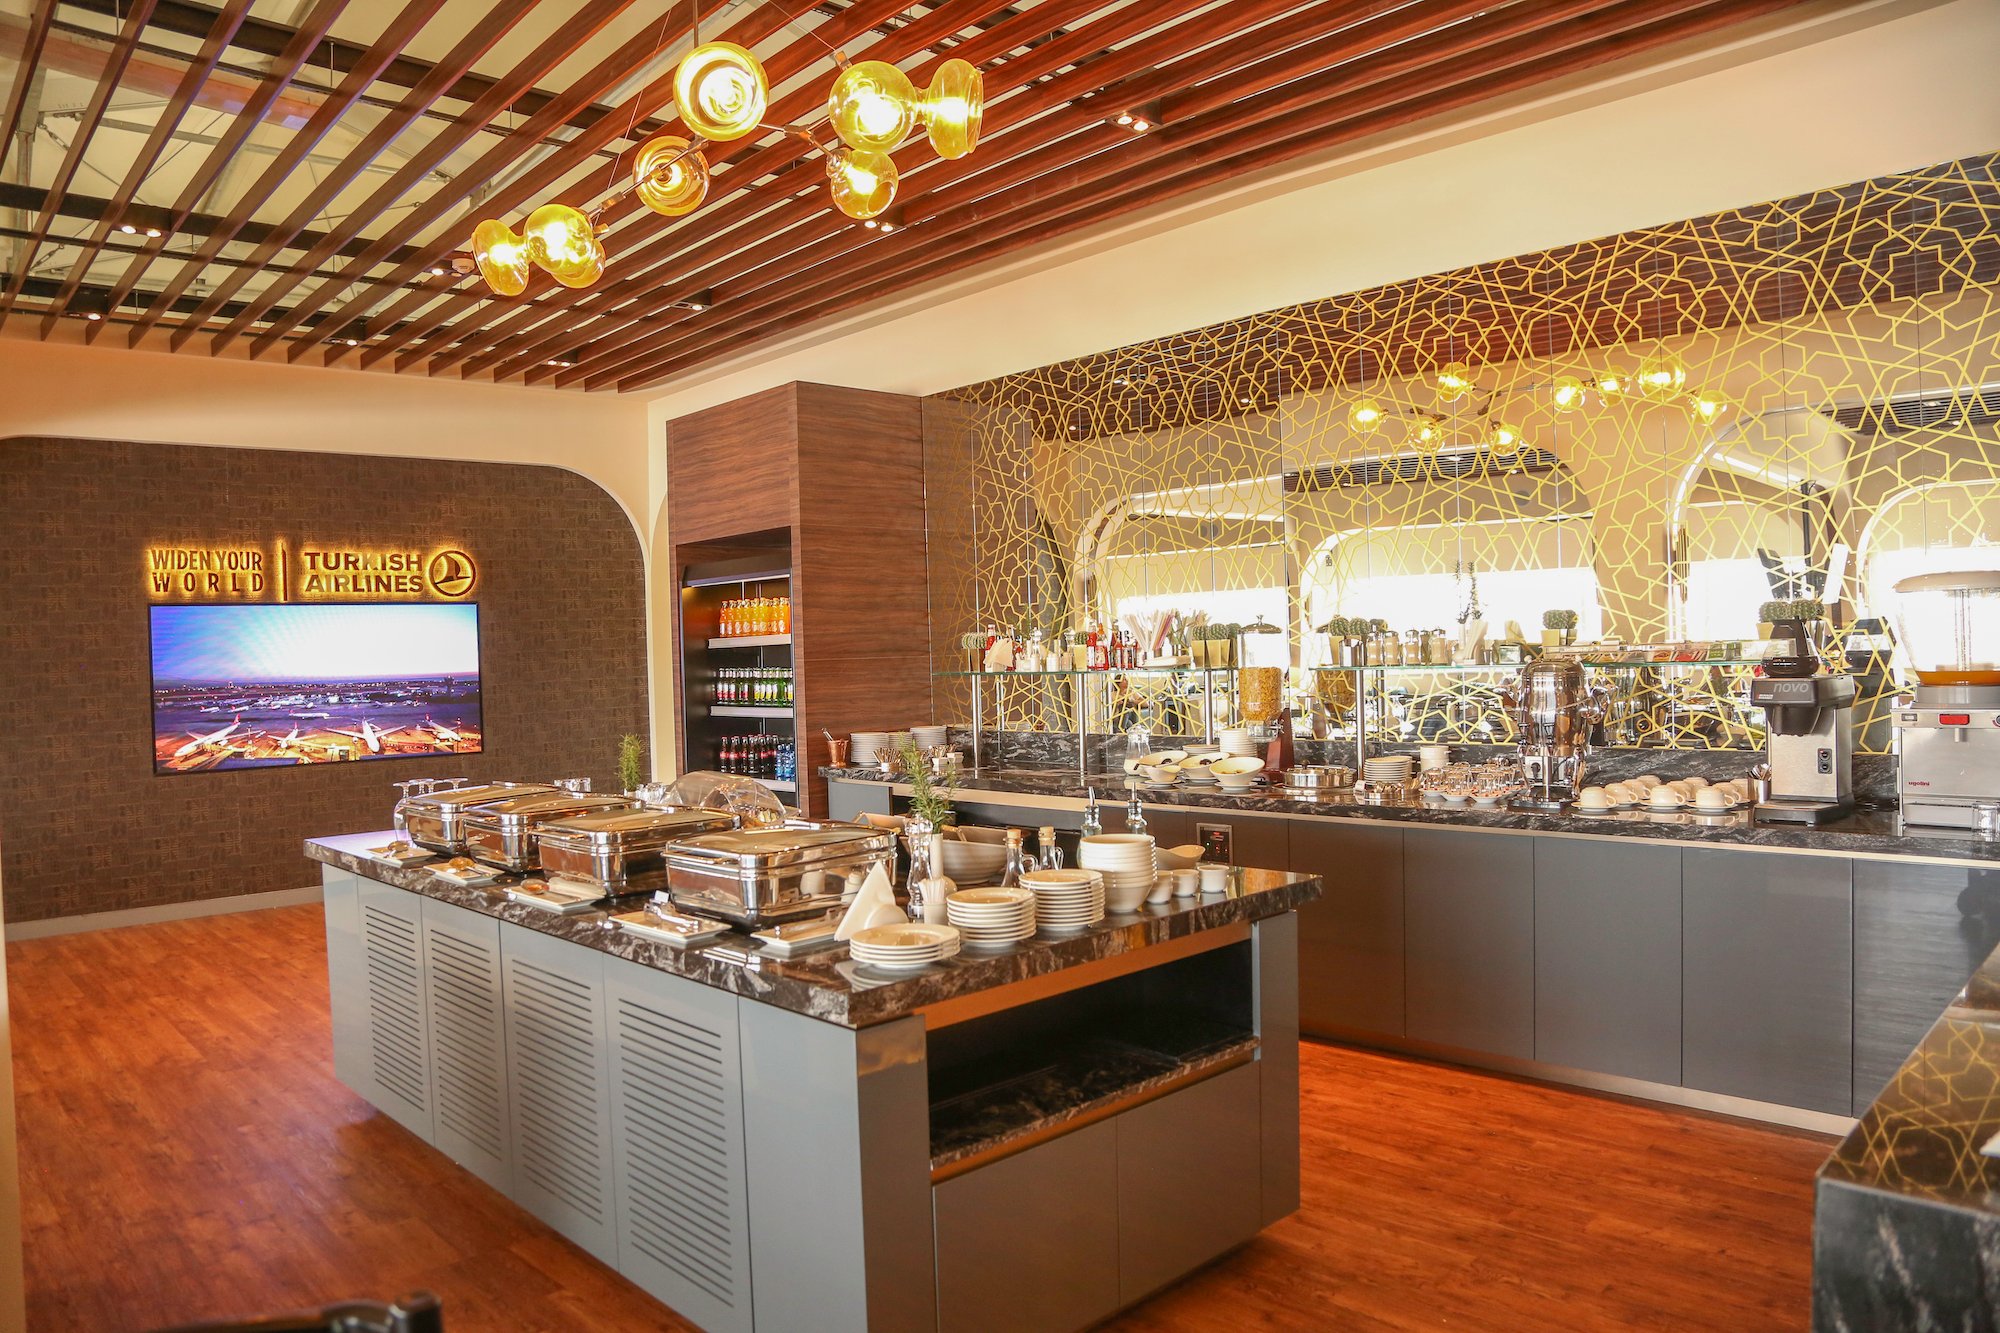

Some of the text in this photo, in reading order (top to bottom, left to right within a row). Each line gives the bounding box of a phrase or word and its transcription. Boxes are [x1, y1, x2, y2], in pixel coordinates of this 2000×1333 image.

[151, 549, 262, 570] WIDEN YOUR
[304, 552, 422, 571] TURKISH
[152, 572, 264, 592] WORLD
[305, 574, 424, 593] AIRLINES
[1773, 682, 1810, 693] novo
